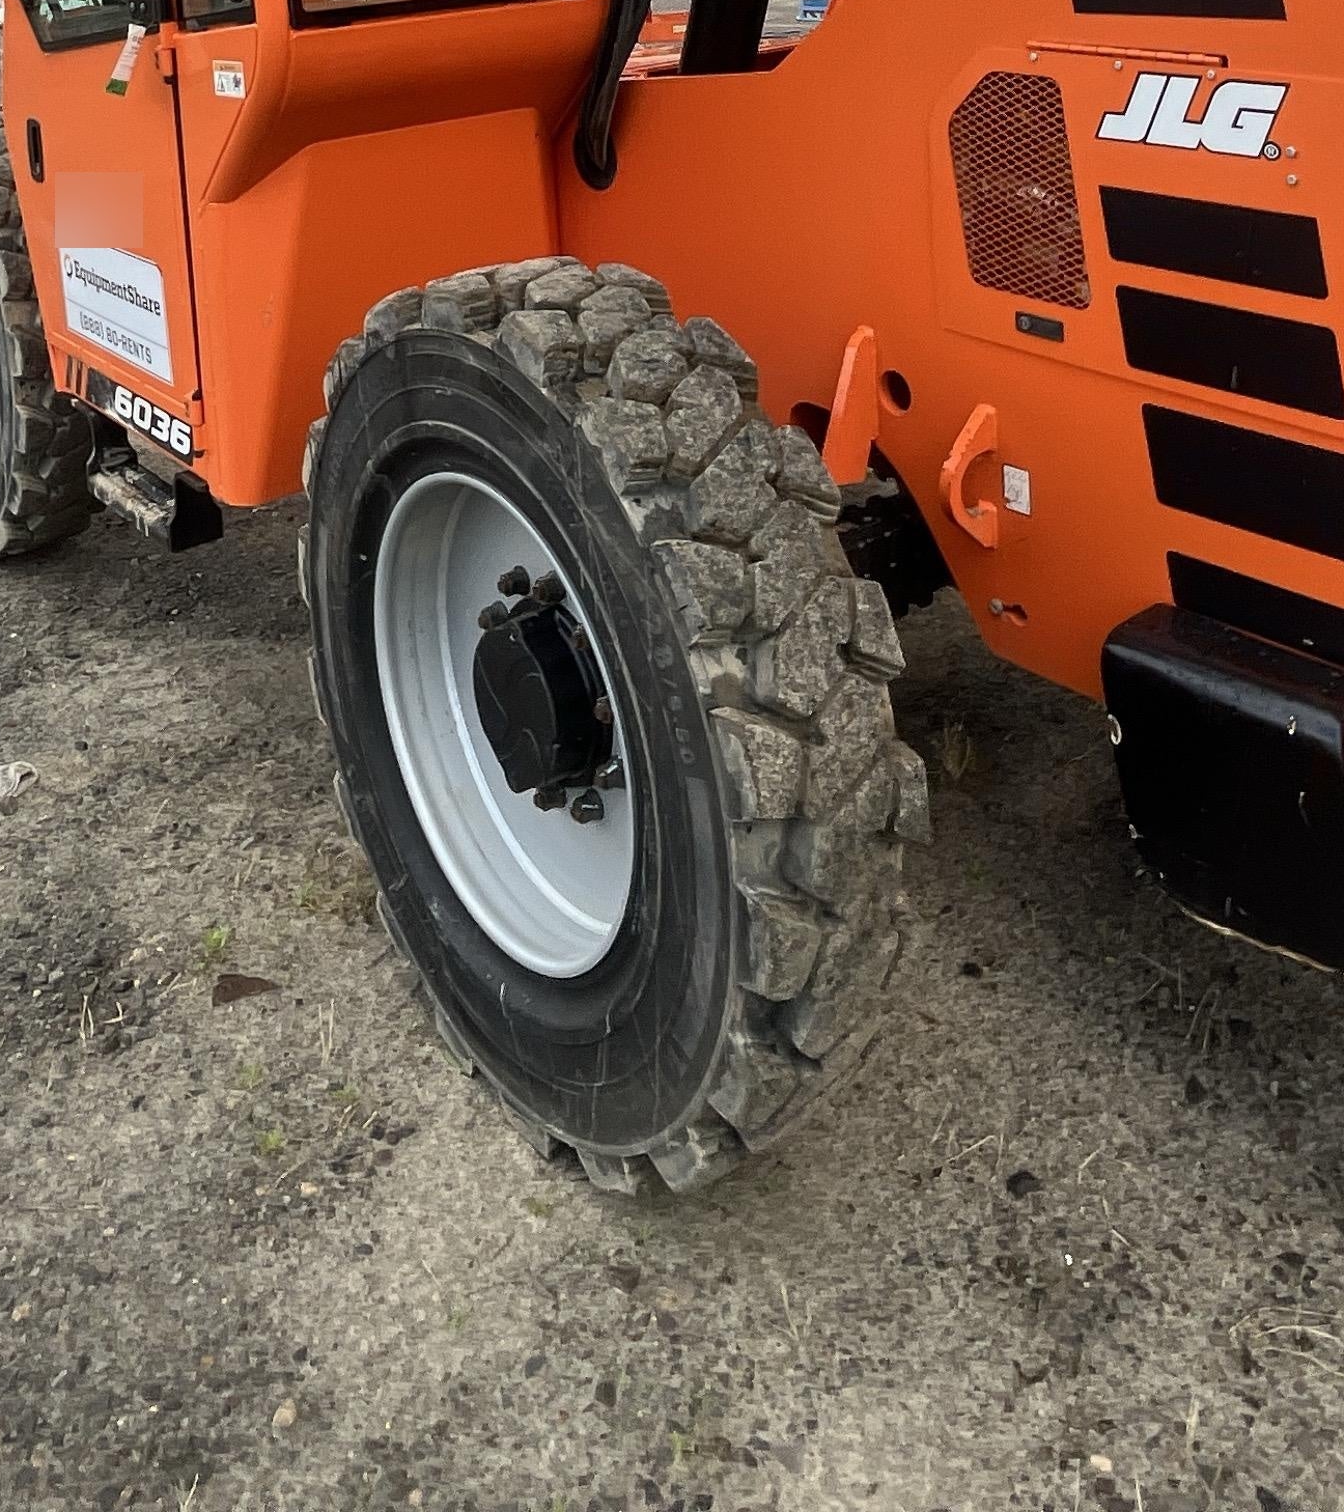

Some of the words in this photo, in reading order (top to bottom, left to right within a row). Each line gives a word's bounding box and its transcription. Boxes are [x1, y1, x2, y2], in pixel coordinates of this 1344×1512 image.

[1095, 71, 1290, 159] JLG
[73, 260, 162, 317] EquipmentShare
[105, 322, 153, 365] 80-RENTS
[113, 384, 192, 456] 6036
